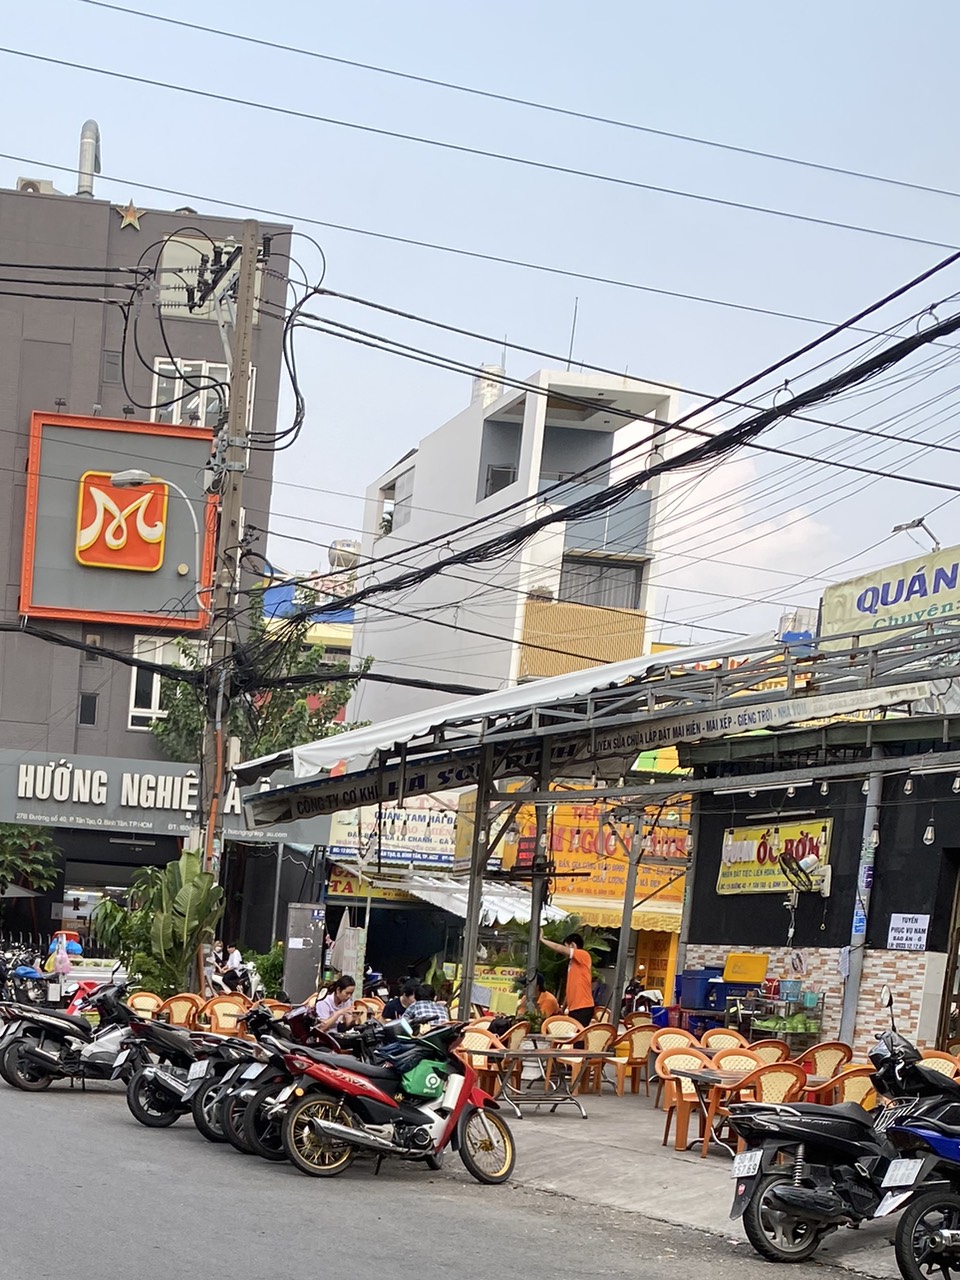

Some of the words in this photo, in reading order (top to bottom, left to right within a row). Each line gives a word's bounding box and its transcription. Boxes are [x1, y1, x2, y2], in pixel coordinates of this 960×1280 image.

[856, 563, 960, 614] QUÁN
[587, 738, 614, 753] CUYÊN
[706, 717, 719, 732] MÁI
[720, 712, 732, 730] XẾP
[737, 708, 757, 727] GIẾNG
[18, 758, 108, 805] HƯỚNG
[120, 770, 200, 819] NGHIỆ
[297, 794, 326, 815] CÔNG
[326, 792, 340, 807] TY
[342, 787, 357, 805] CƠ
[360, 781, 380, 802] KHÍ
[438, 762, 481, 786] SƠ
[29, 813, 49, 822] Đường
[757, 829, 778, 864] ỐC
